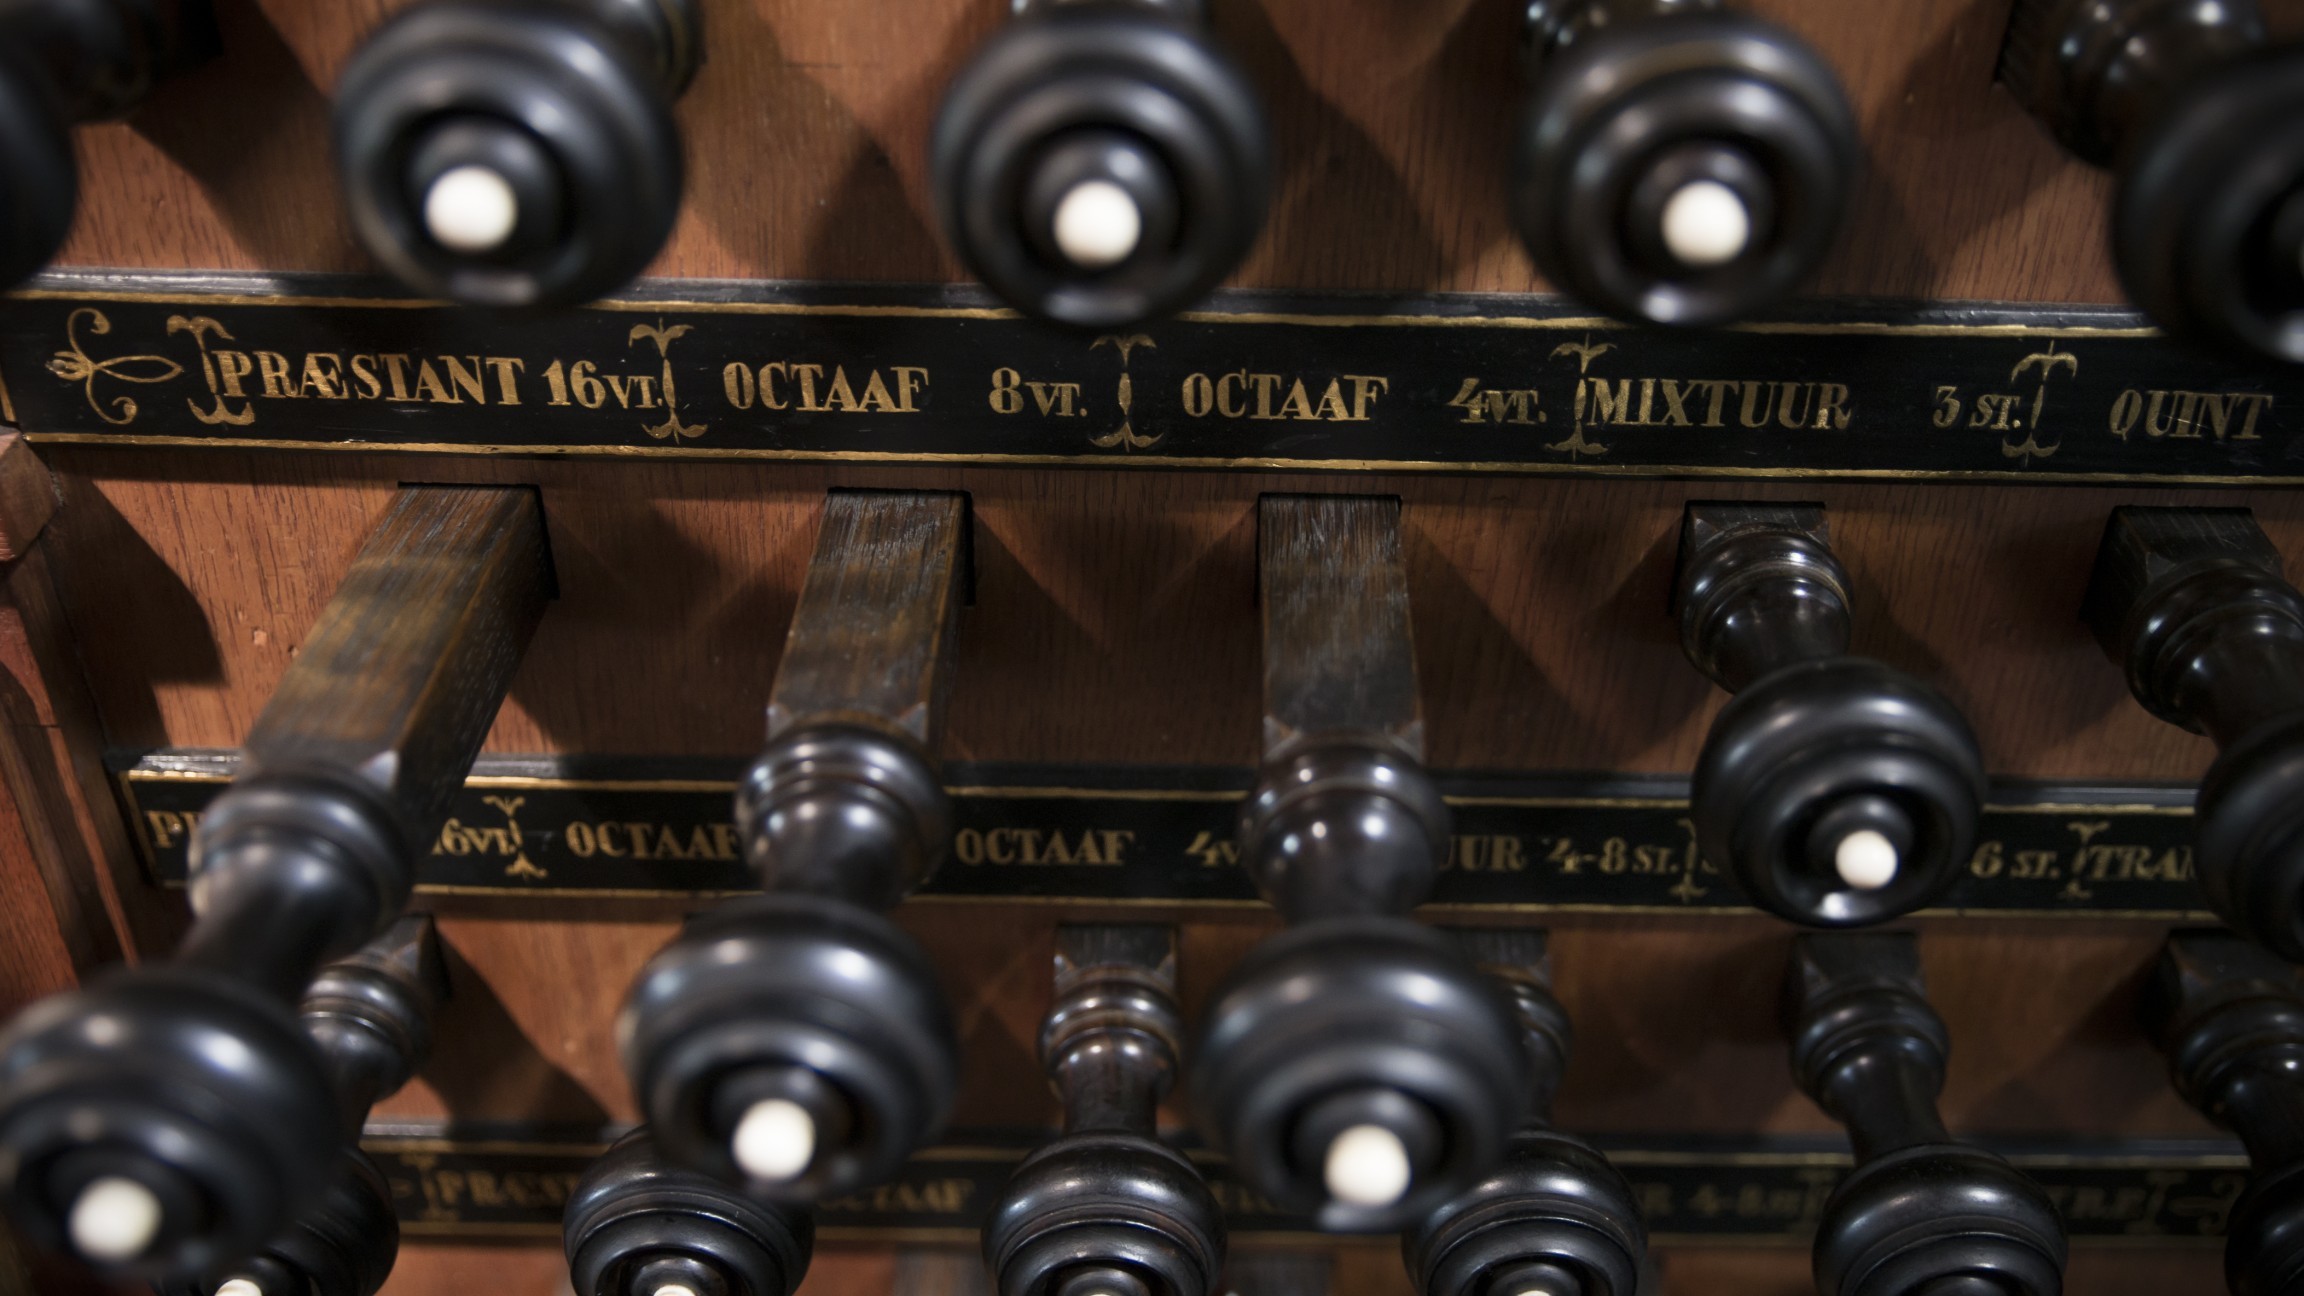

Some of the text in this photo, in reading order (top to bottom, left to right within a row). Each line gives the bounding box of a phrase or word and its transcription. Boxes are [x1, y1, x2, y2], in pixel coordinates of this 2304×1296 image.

[211, 350, 525, 406] PRÆSTANT
[722, 361, 930, 413] OCTAAF
[1182, 368, 1388, 421] OCTAAF
[1586, 376, 1853, 430] MIXTUUR
[2107, 388, 2274, 441] QUINT
[955, 827, 1135, 867] OCTAAF
